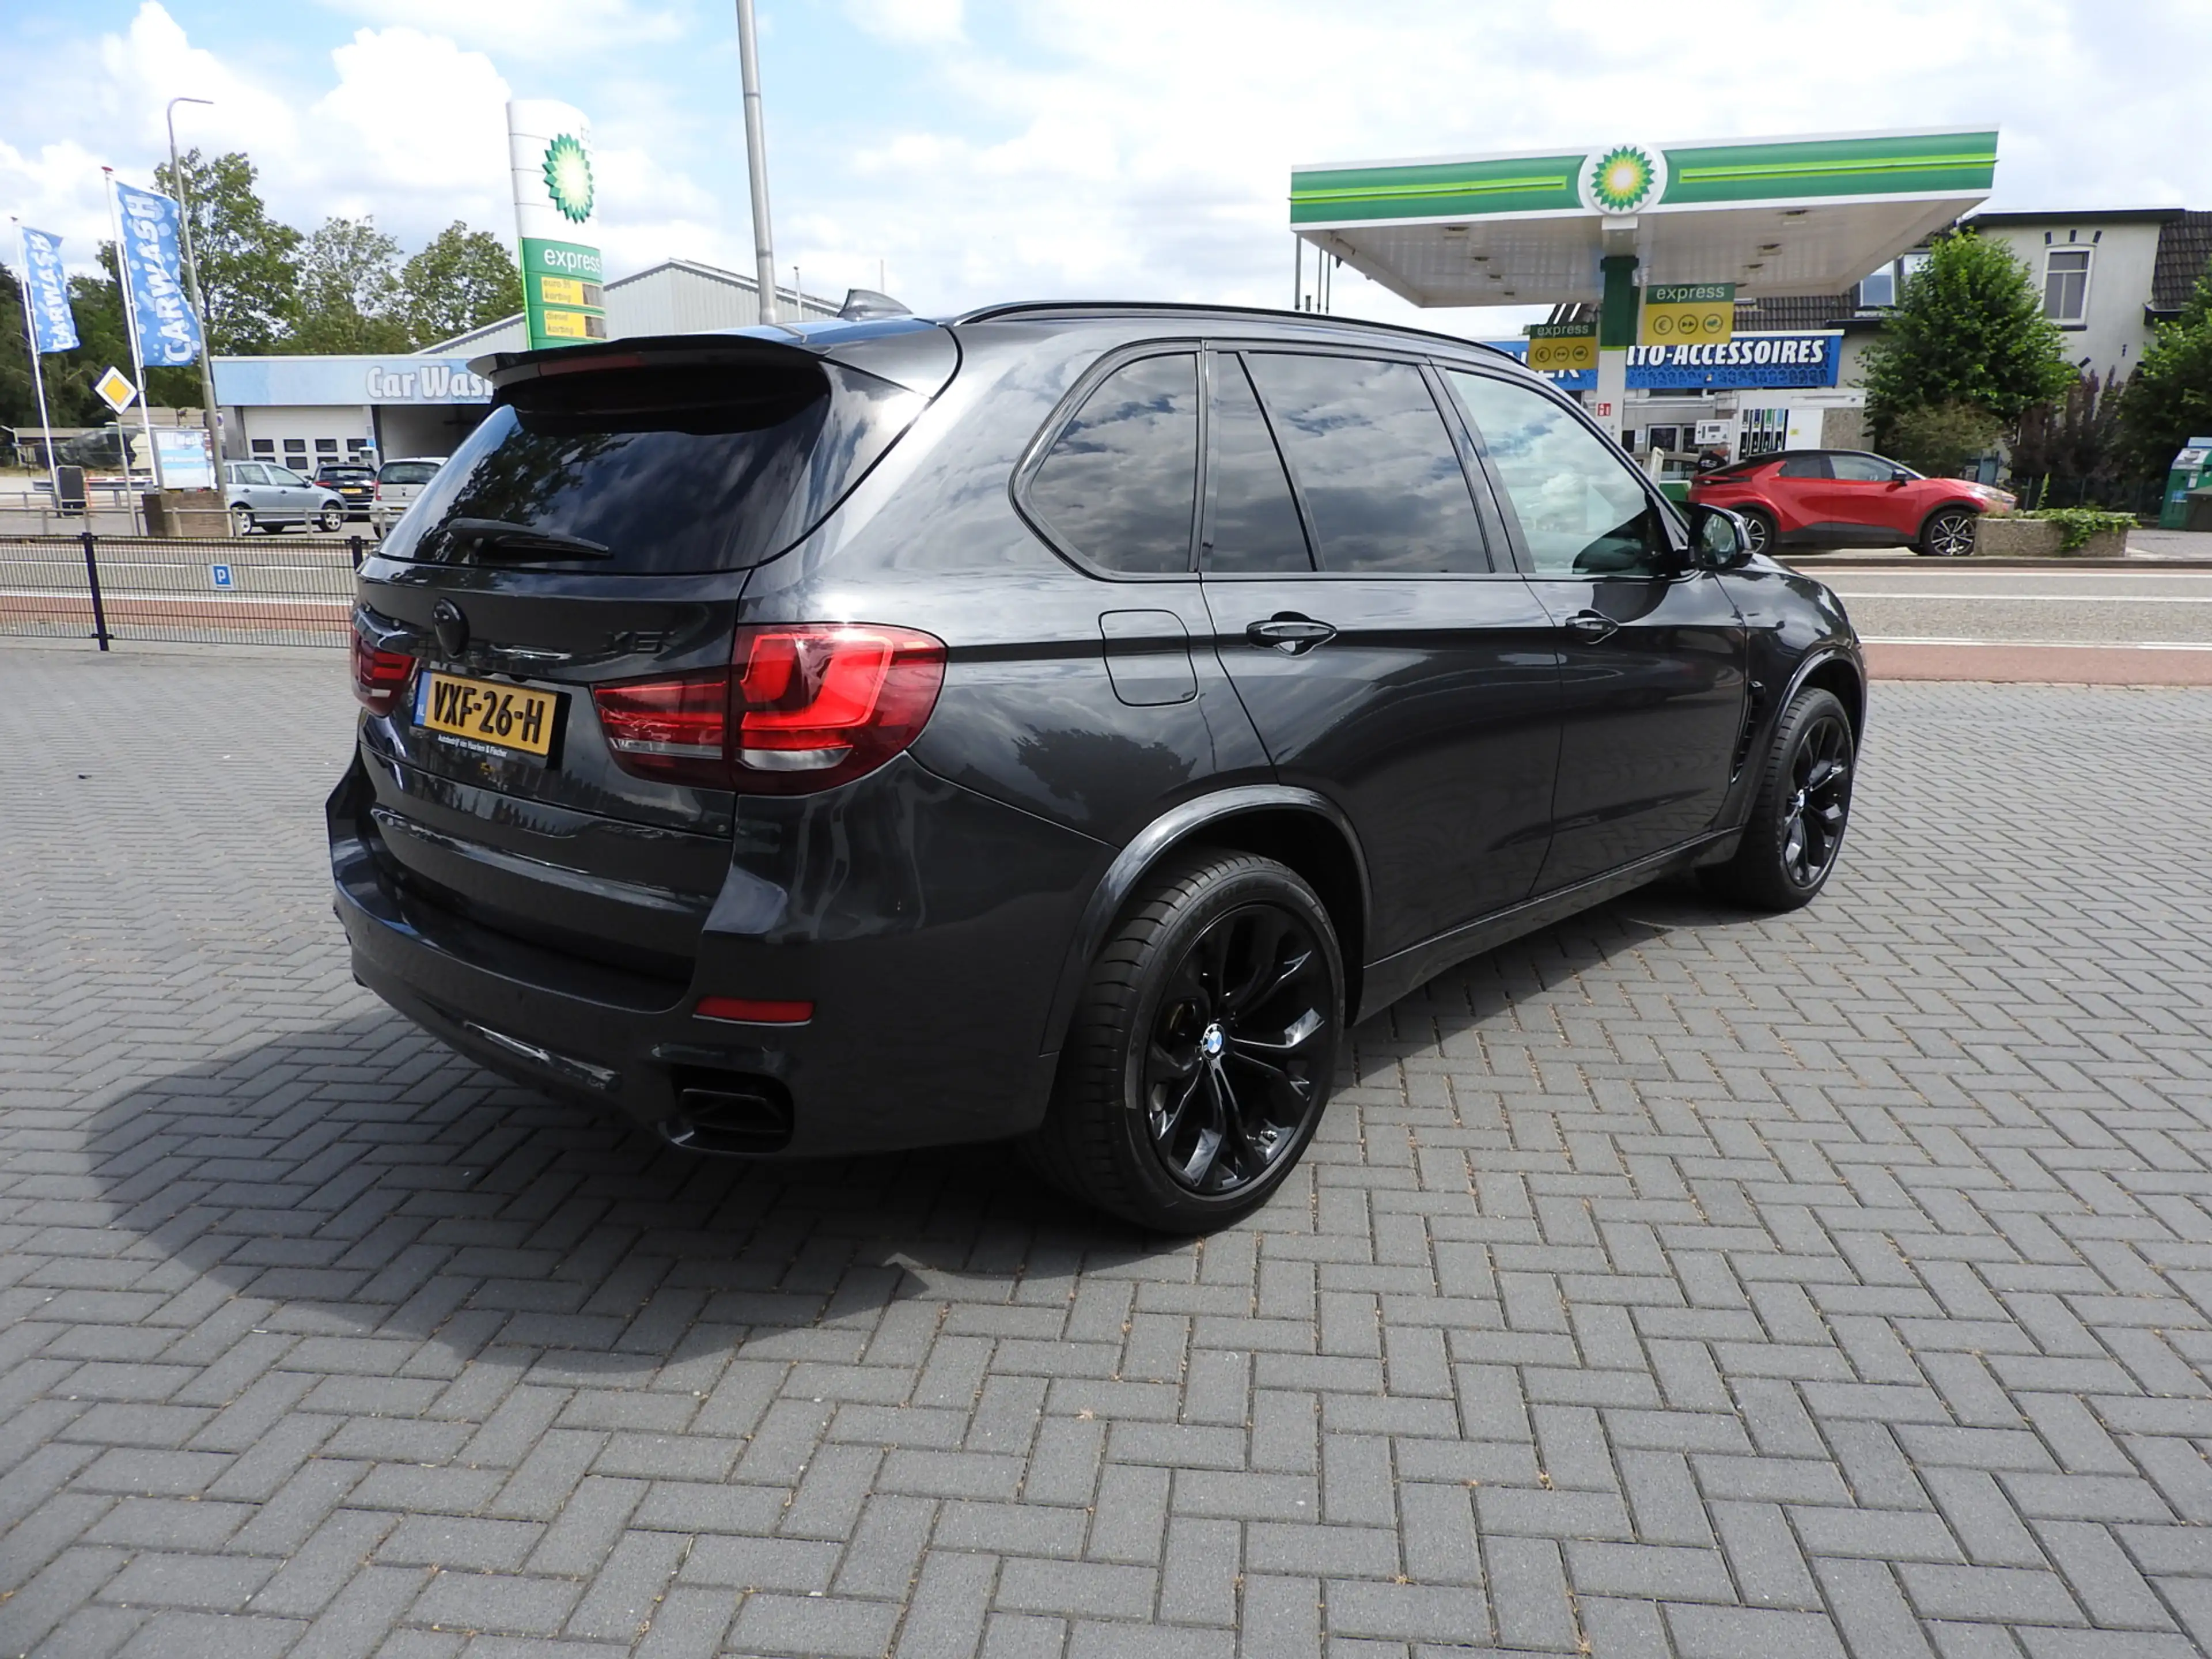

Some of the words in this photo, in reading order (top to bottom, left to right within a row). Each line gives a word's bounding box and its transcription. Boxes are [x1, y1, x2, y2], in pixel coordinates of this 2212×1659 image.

[544, 248, 601, 273] express
[123, 193, 193, 362] CARWASH
[1656, 286, 1725, 302] express
[1537, 324, 1589, 338] express
[1627, 340, 1825, 366] TO-ACCESSOIRES
[367, 366, 415, 398] Car
[217, 569, 226, 582] P
[416, 703, 425, 717] NL
[434, 680, 546, 744] VXF-26-H
